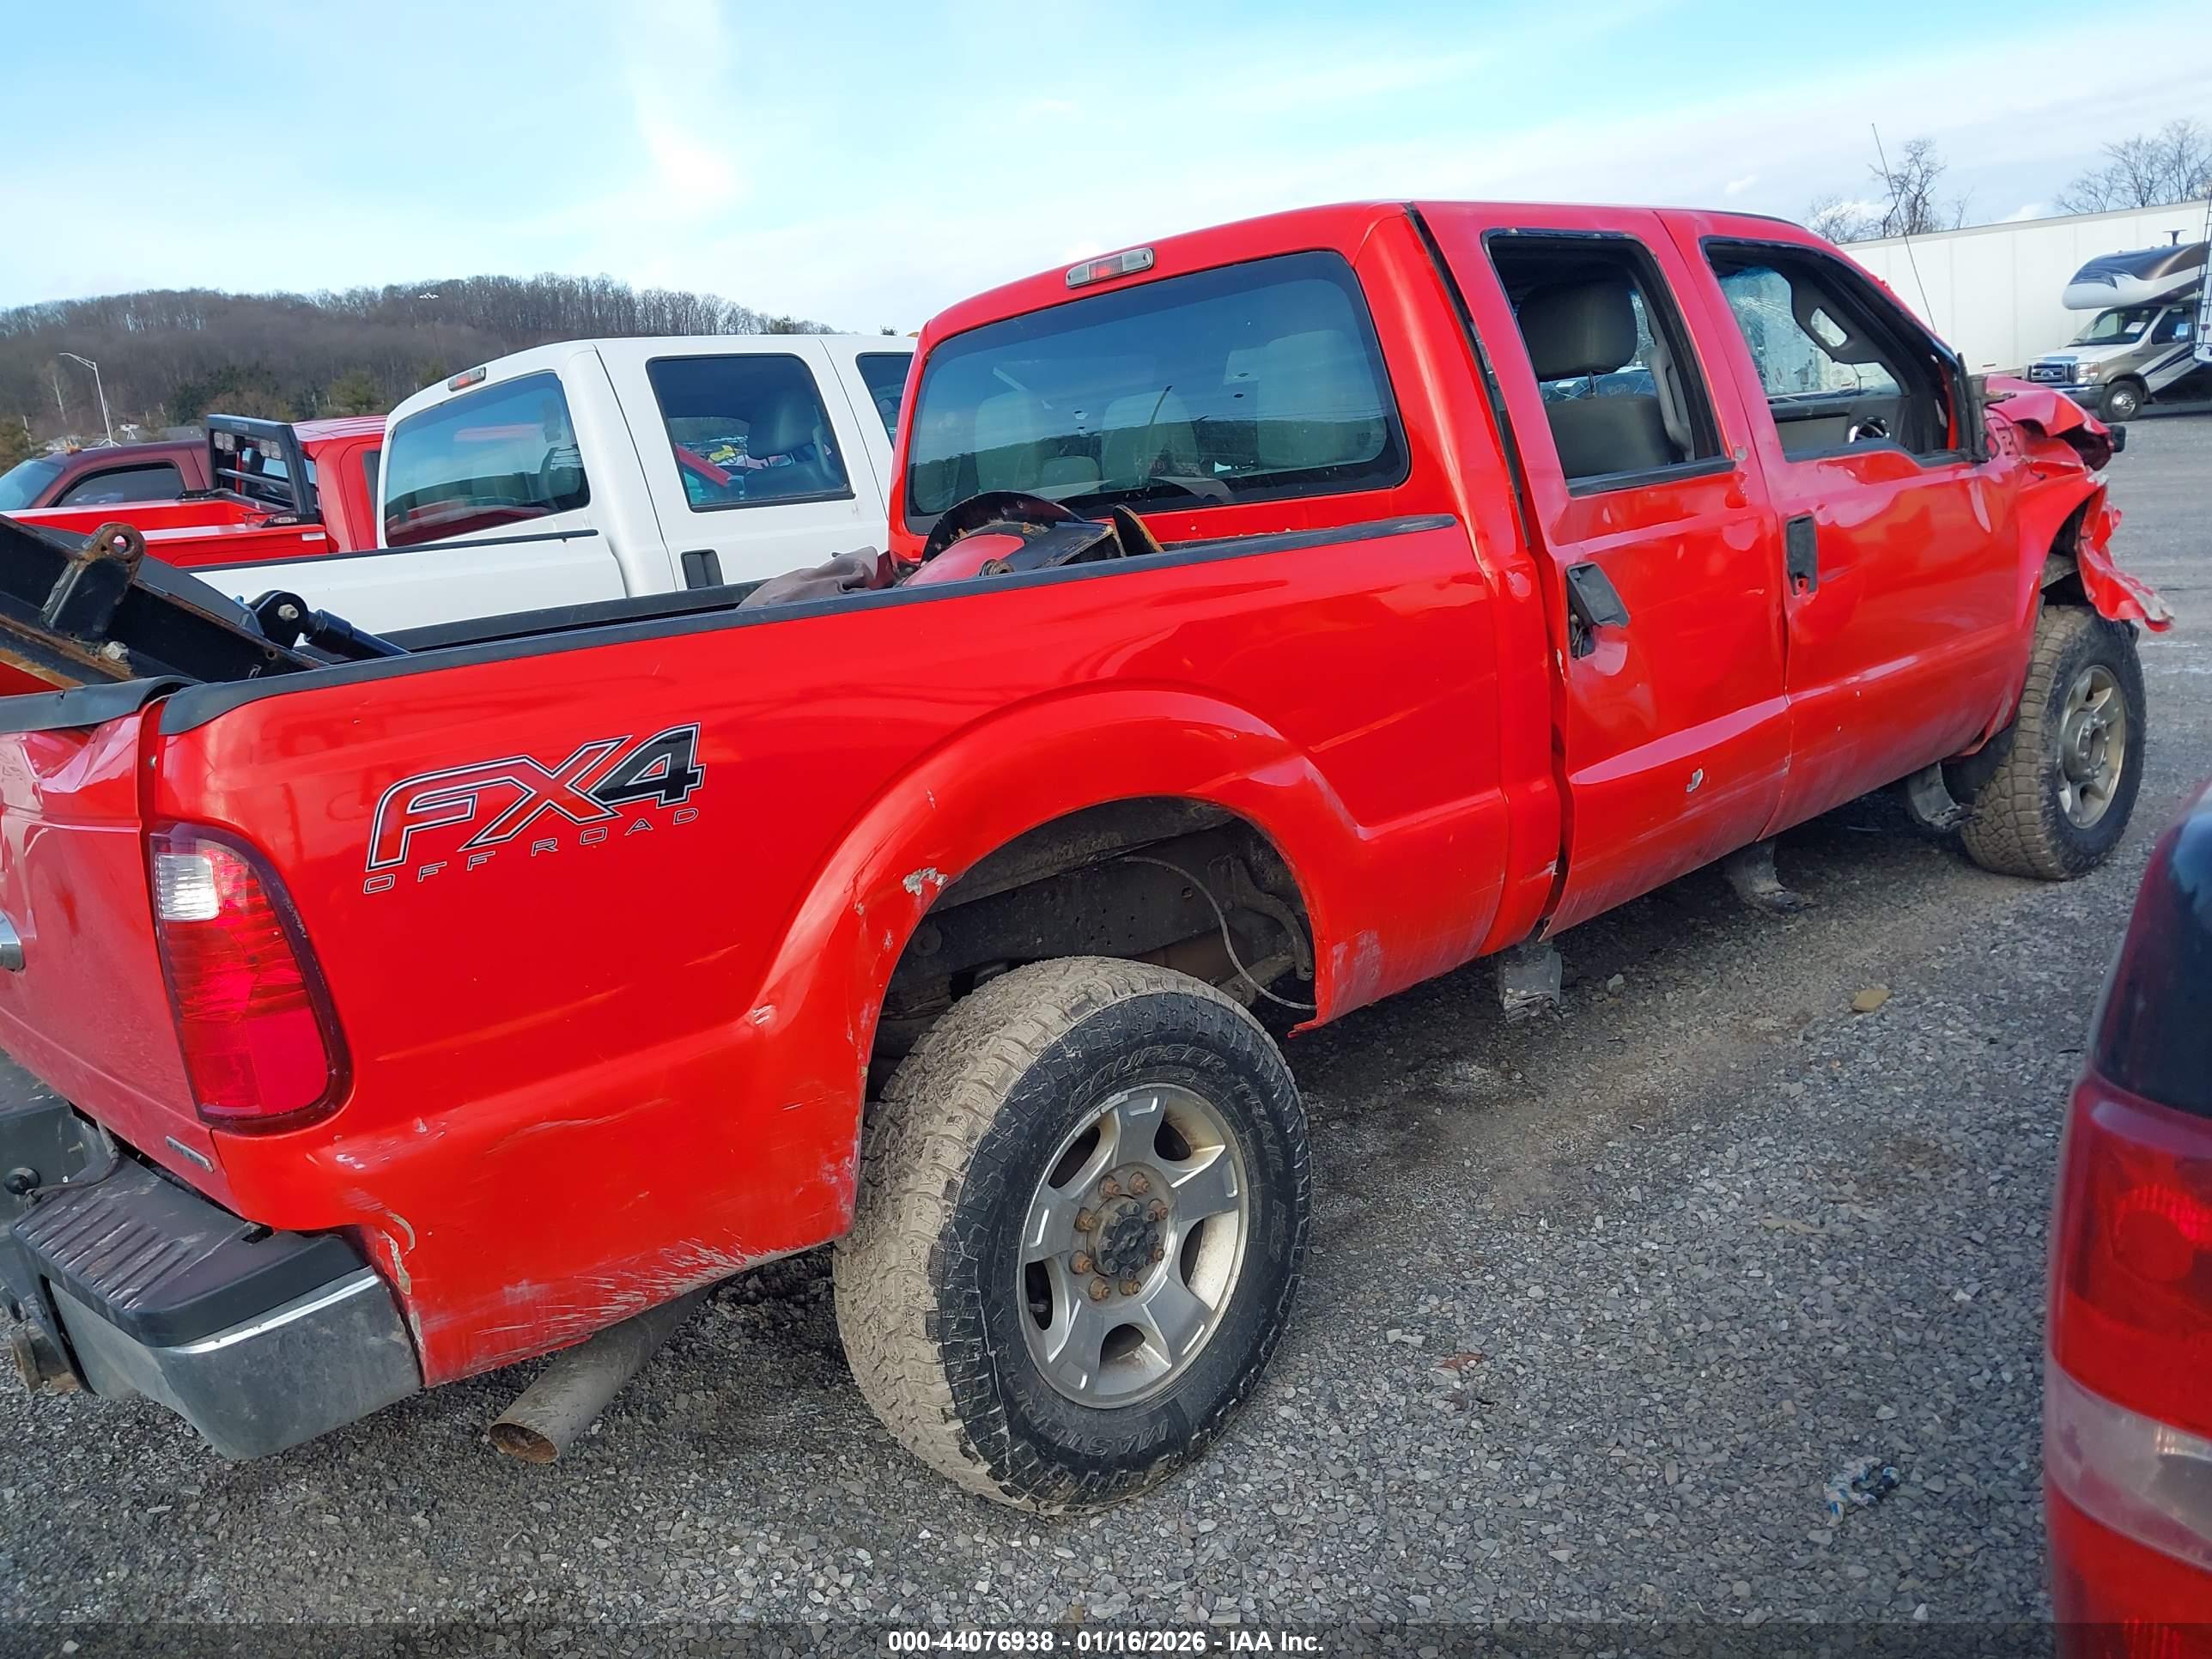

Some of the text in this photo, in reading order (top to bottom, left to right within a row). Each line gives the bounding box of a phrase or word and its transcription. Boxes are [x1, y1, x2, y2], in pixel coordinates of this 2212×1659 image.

[365, 721, 706, 872] FX4
[363, 807, 699, 895] OFF ROAD
[1067, 1043, 1228, 1114] COURSER
